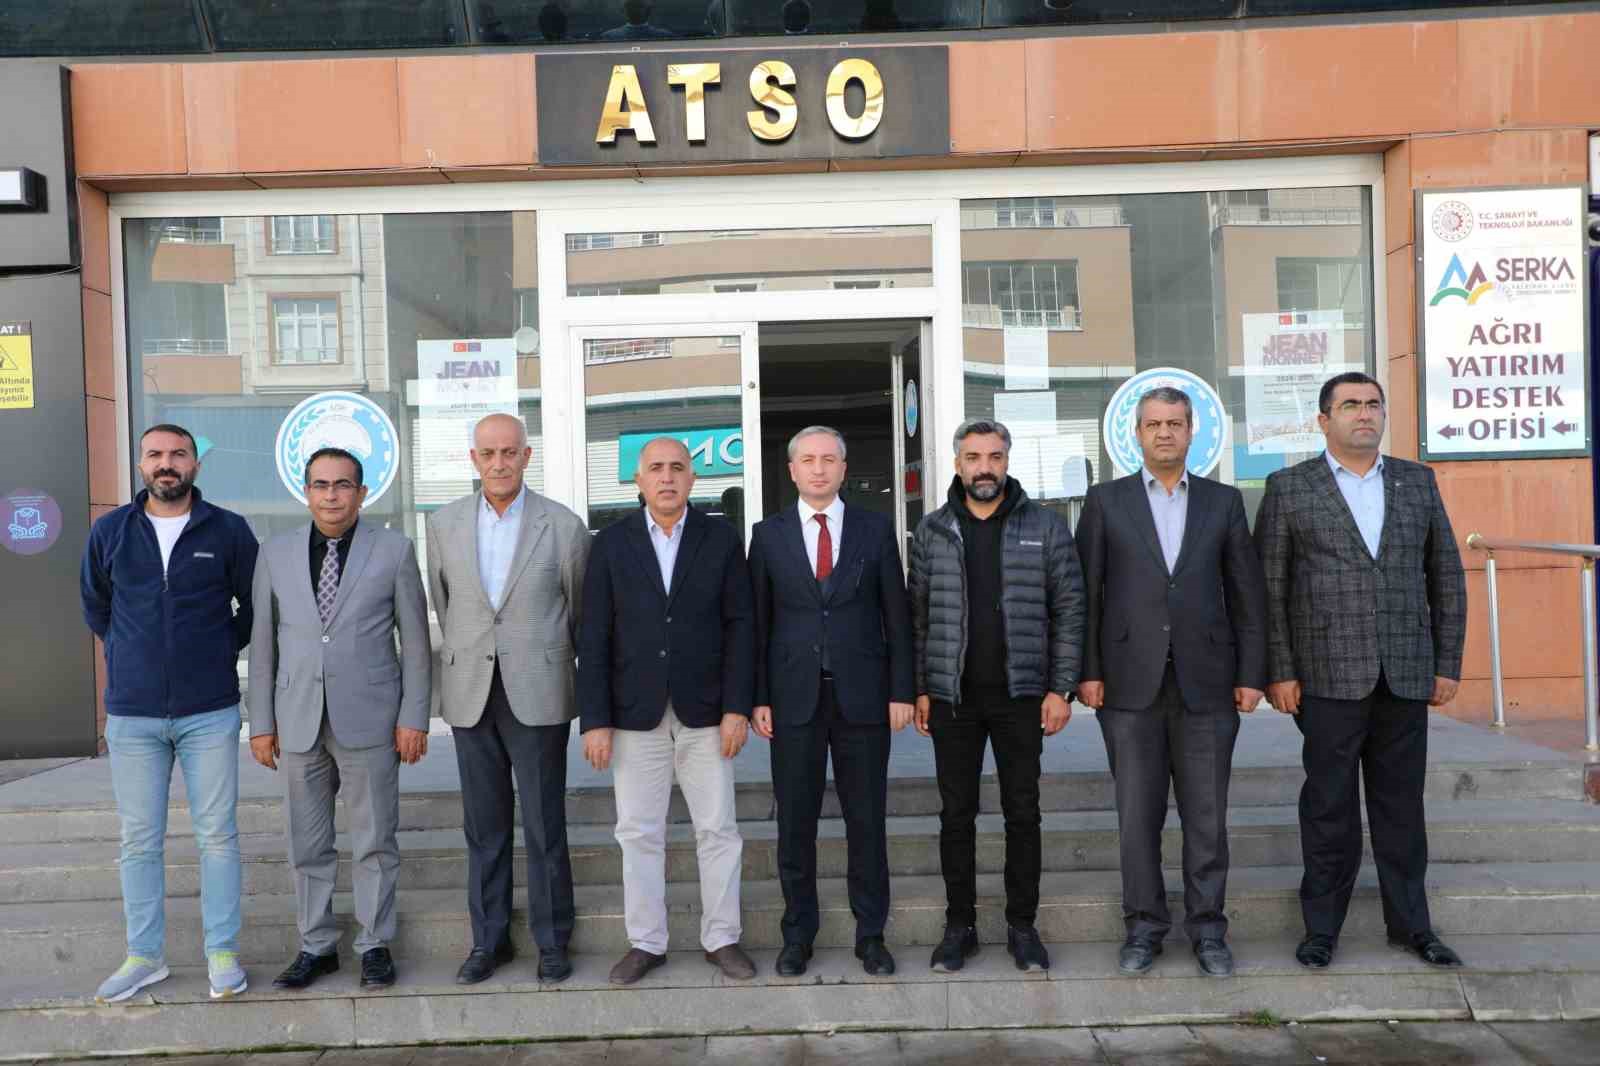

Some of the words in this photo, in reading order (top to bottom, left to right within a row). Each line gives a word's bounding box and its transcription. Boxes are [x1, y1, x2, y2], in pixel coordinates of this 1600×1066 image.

[595, 58, 885, 145] ATSO
[1496, 256, 1576, 281] SERKA
[1262, 332, 1328, 352] JEAN
[1468, 316, 1542, 346] AĞRI
[436, 360, 501, 379] JEAN
[1446, 354, 1565, 378] YATIRIM
[1452, 385, 1565, 410] DESTEK
[1468, 411, 1547, 441] OFİSİ
